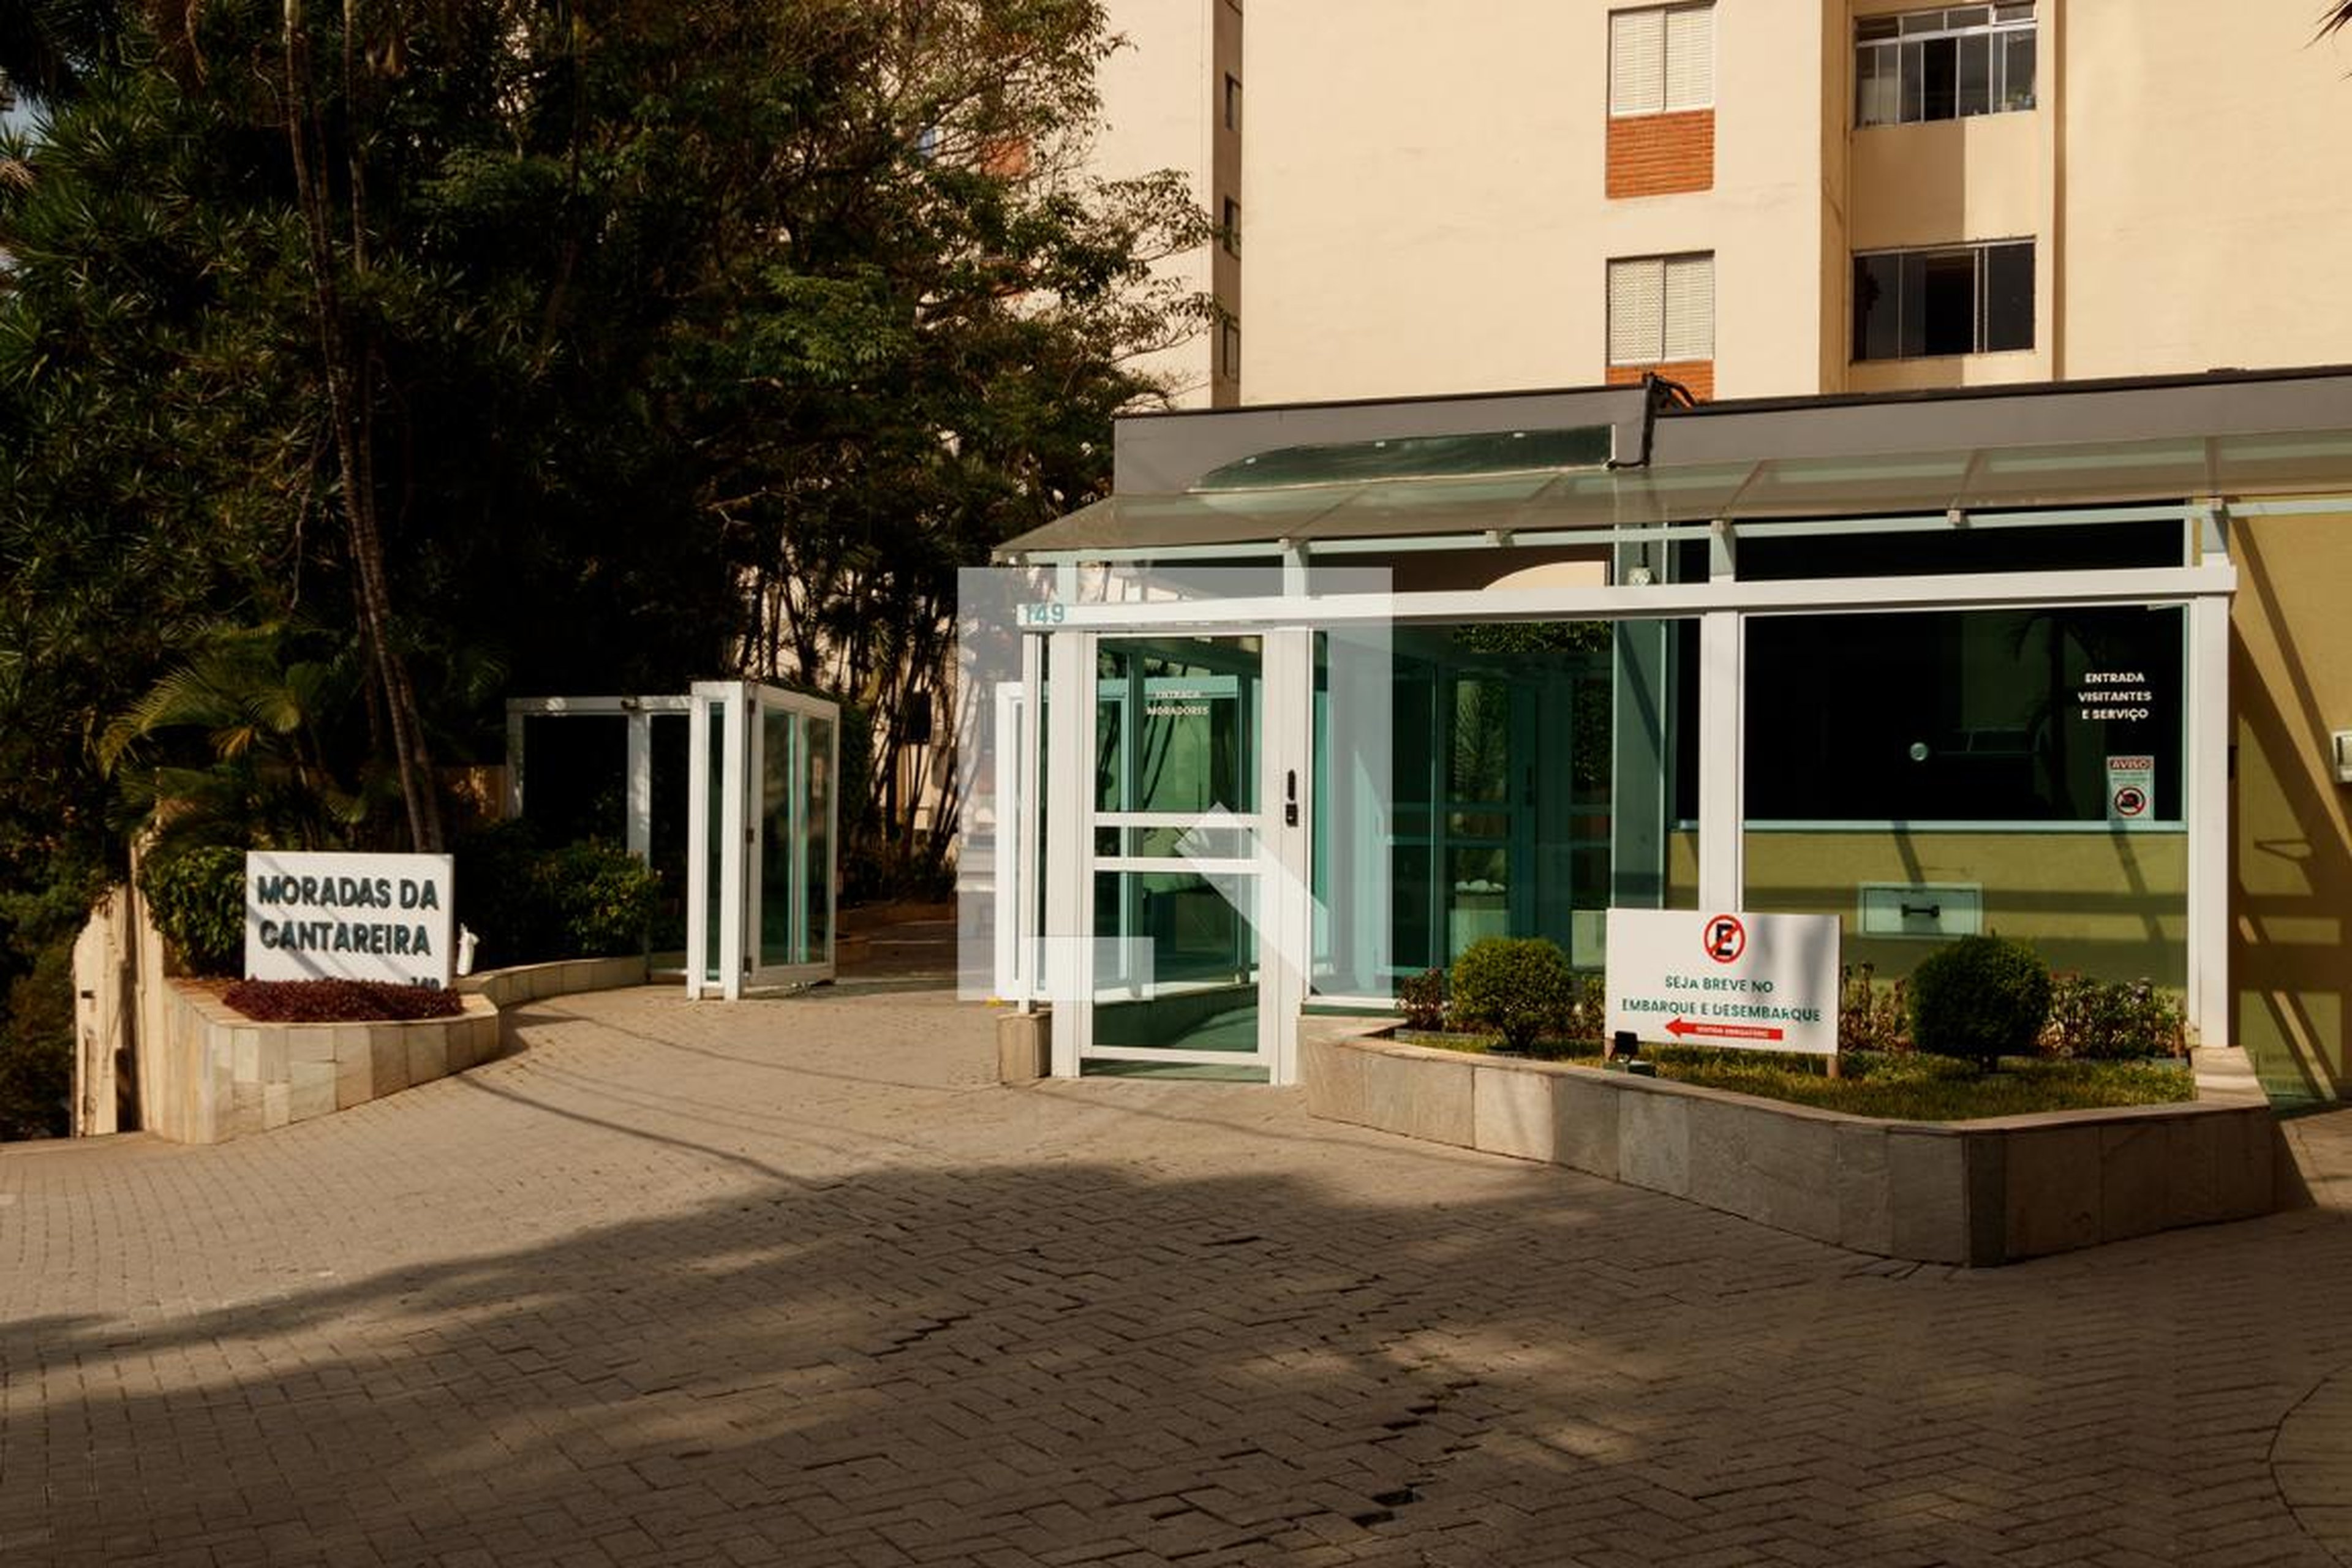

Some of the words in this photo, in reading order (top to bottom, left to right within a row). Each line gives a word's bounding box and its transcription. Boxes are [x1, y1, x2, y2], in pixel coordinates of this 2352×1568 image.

[1024, 604, 1064, 623] 149
[2085, 673, 2145, 683] ENTRADA
[2078, 691, 2152, 703] VISITANTES
[1147, 705, 1209, 715] MORADORES
[2082, 709, 2089, 720] E
[2092, 708, 2149, 722] SERVIÇO
[2113, 760, 2147, 769] AVISO
[258, 875, 391, 909] MORADAS
[399, 878, 439, 910] DA
[260, 920, 431, 956] CANTAREIRA
[1665, 976, 1698, 990] SEJA
[1703, 978, 1746, 992] BREVE
[1751, 981, 1774, 993] NO
[1622, 998, 1696, 1016] EMBARQUE
[1701, 1003, 1708, 1015] E
[1713, 1003, 1821, 1022] DESEMBARQUE
